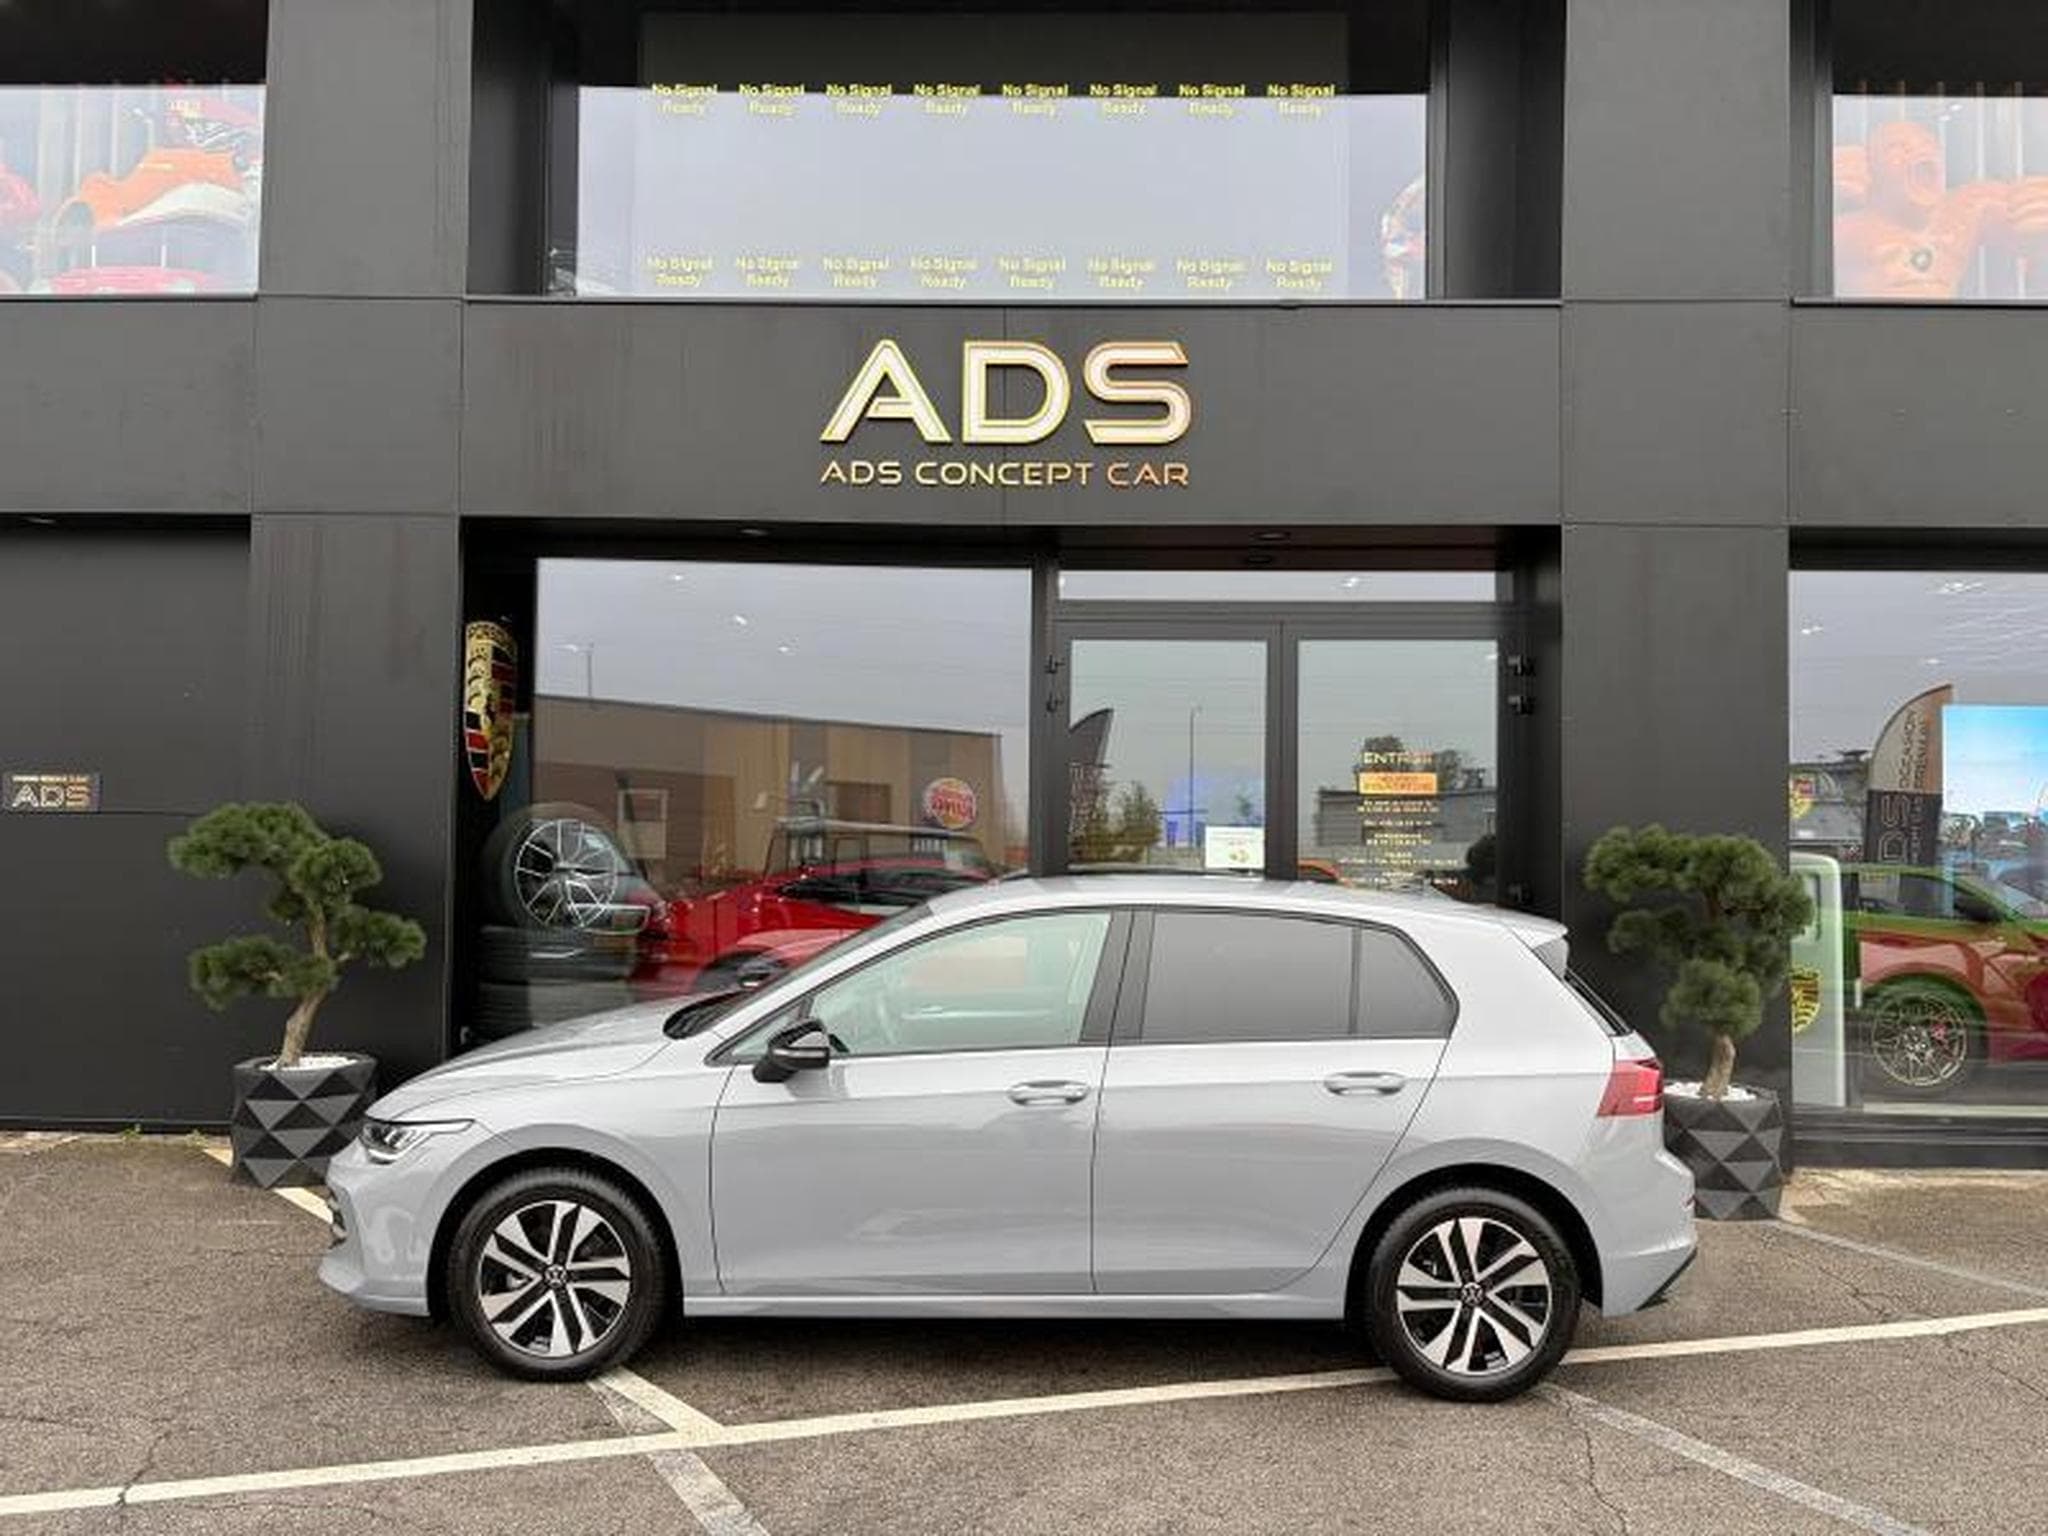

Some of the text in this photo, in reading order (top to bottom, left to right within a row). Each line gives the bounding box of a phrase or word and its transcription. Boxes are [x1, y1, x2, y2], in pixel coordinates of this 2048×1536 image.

[651, 84, 718, 97] No Signal
[738, 84, 805, 97] No Signal
[825, 84, 892, 97] No Signal
[913, 84, 981, 97] No Signal
[1002, 84, 1068, 97] No Signal
[1089, 84, 1157, 97] No Signal
[1178, 84, 1245, 97] No Signal
[1267, 84, 1334, 97] No Signal
[820, 338, 1193, 445] ADS
[820, 461, 1190, 486] ADS CONCEPT CAR
[12, 784, 90, 807] ADS
[1877, 795, 1911, 864] DS
